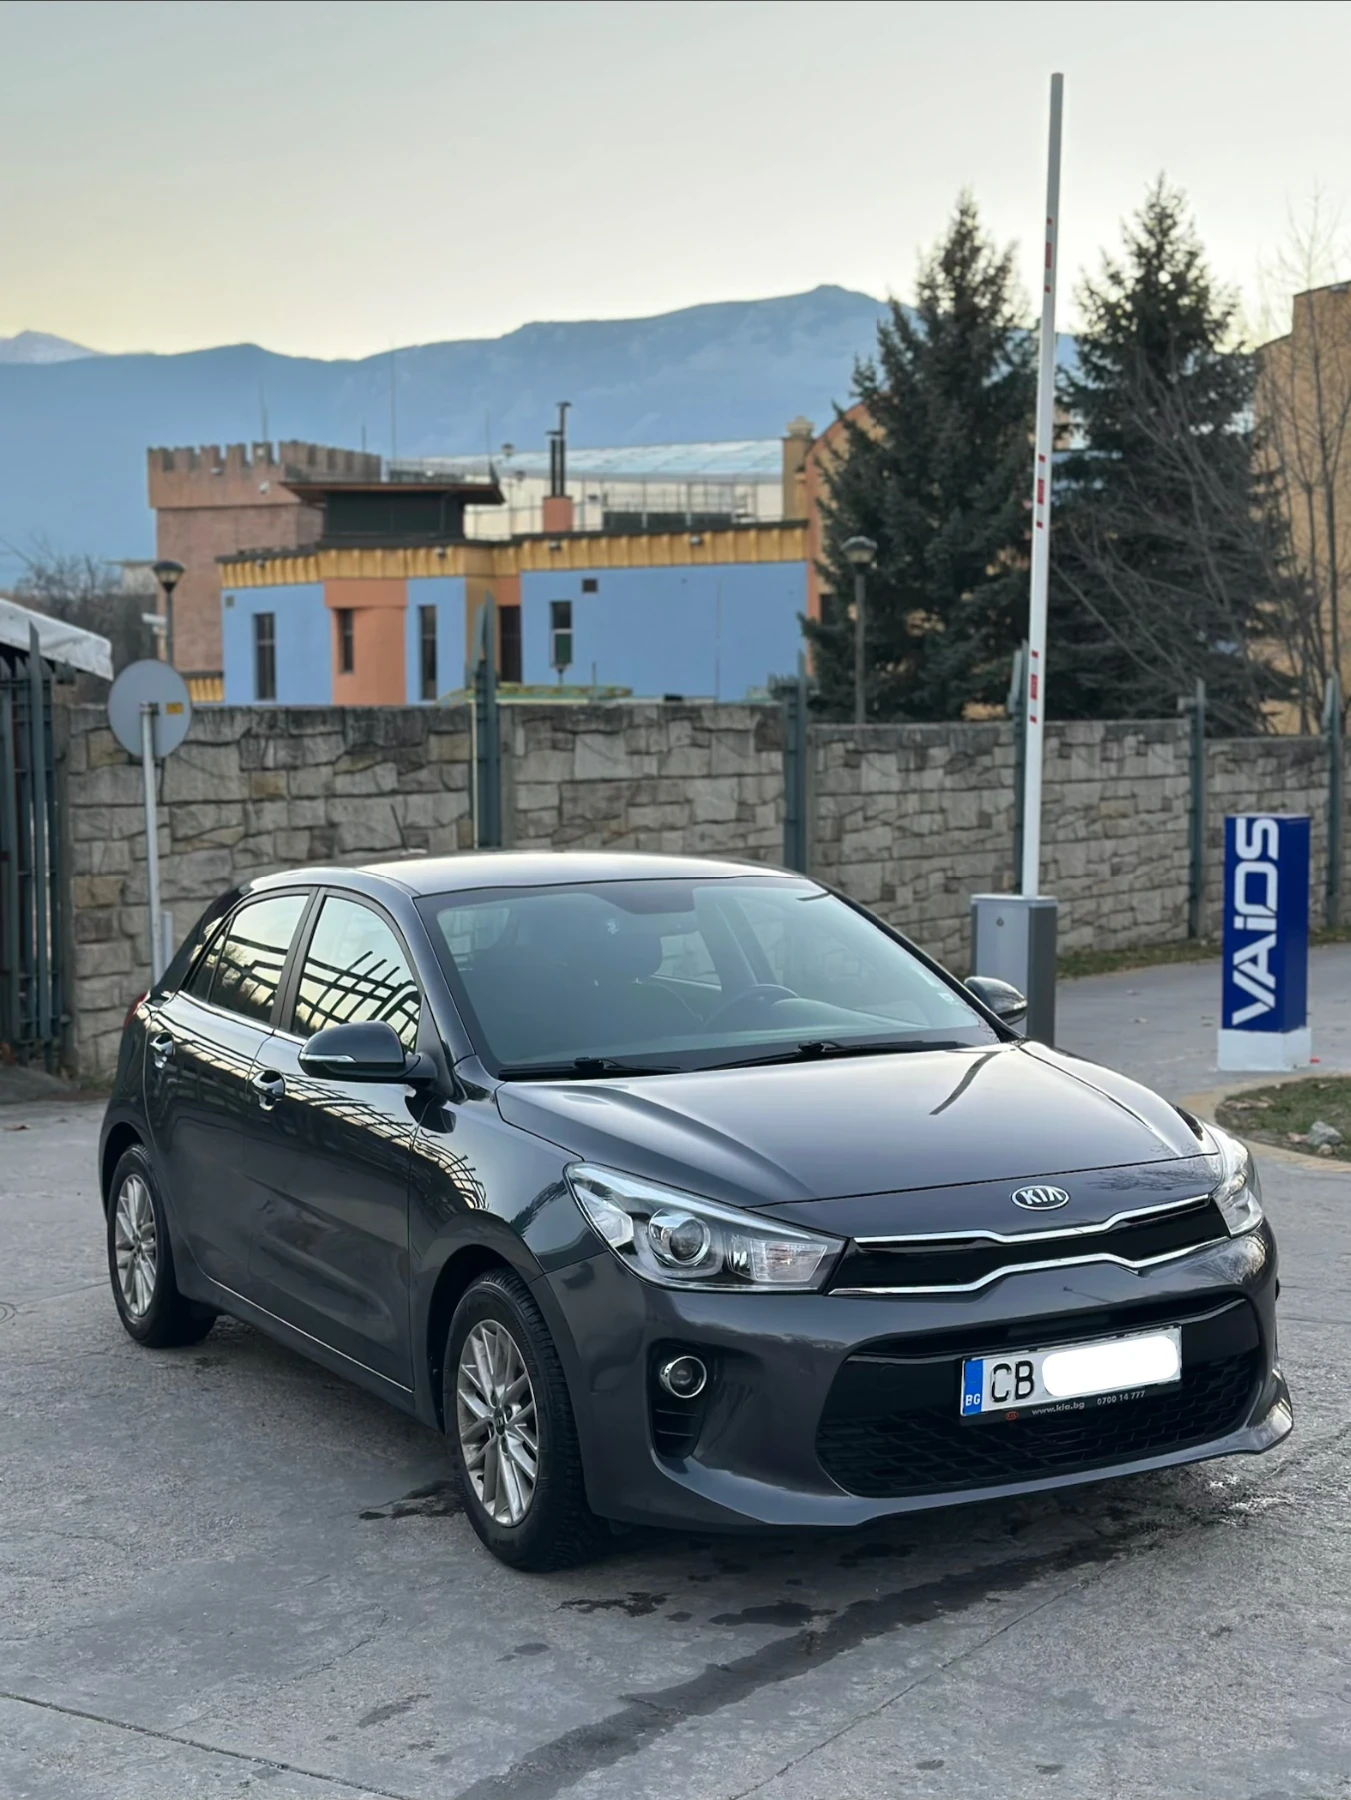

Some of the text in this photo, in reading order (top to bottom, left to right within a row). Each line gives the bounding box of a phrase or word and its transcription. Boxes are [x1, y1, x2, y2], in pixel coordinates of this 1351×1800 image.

[1020, 1187, 1063, 1205] KIA
[991, 1360, 1035, 1403] CB
[965, 1394, 981, 1406] BG
[1032, 1401, 1085, 1416] www.kia.bg
[1097, 1396, 1117, 1405] 0700
[1131, 1391, 1146, 1400] 777
